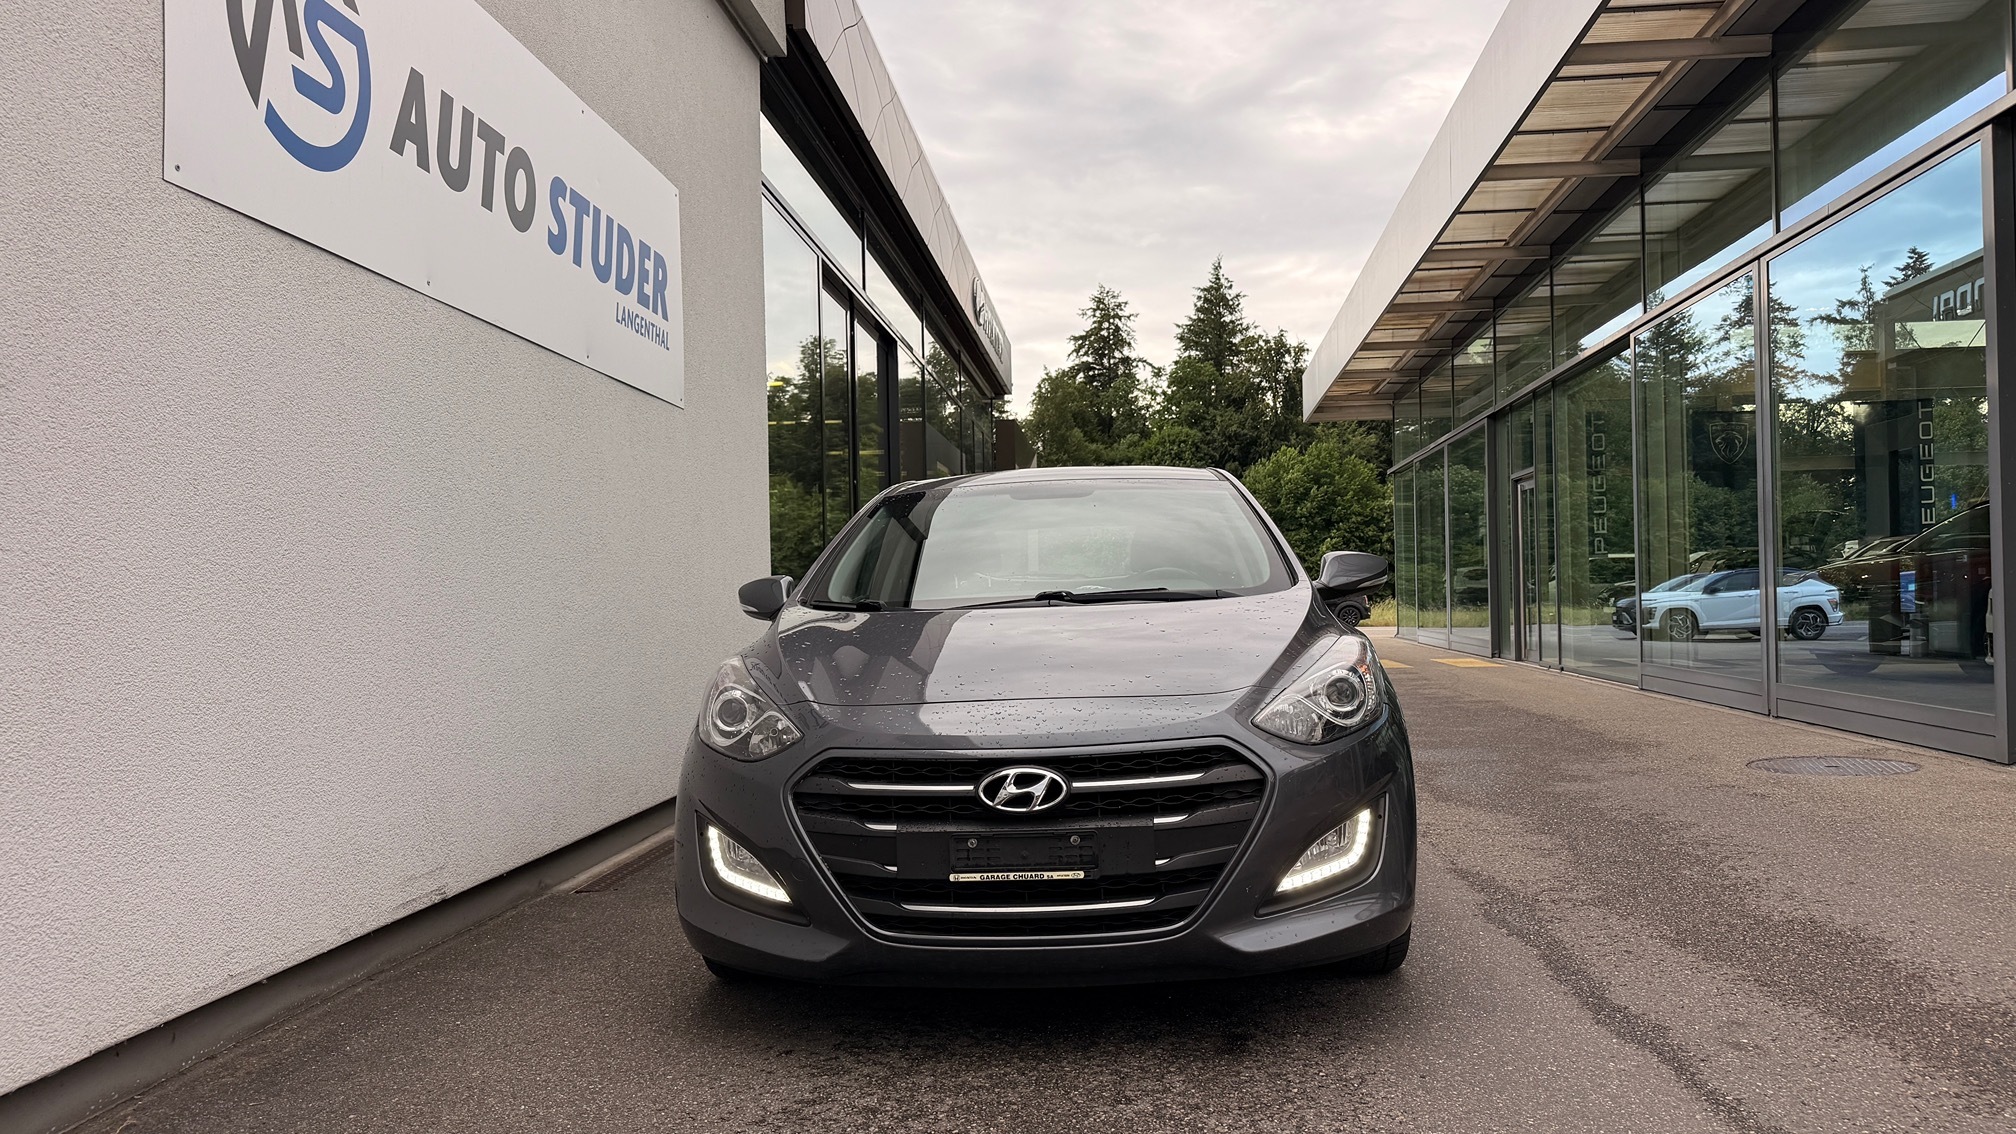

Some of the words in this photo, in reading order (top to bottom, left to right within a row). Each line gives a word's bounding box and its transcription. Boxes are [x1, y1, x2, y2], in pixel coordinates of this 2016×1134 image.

[389, 66, 536, 233] AUTO
[547, 176, 669, 322] STUDER
[615, 302, 670, 351] LANGENTHAL
[1592, 414, 1608, 554] PEUGEOT
[1919, 401, 1936, 530] EUGEOT
